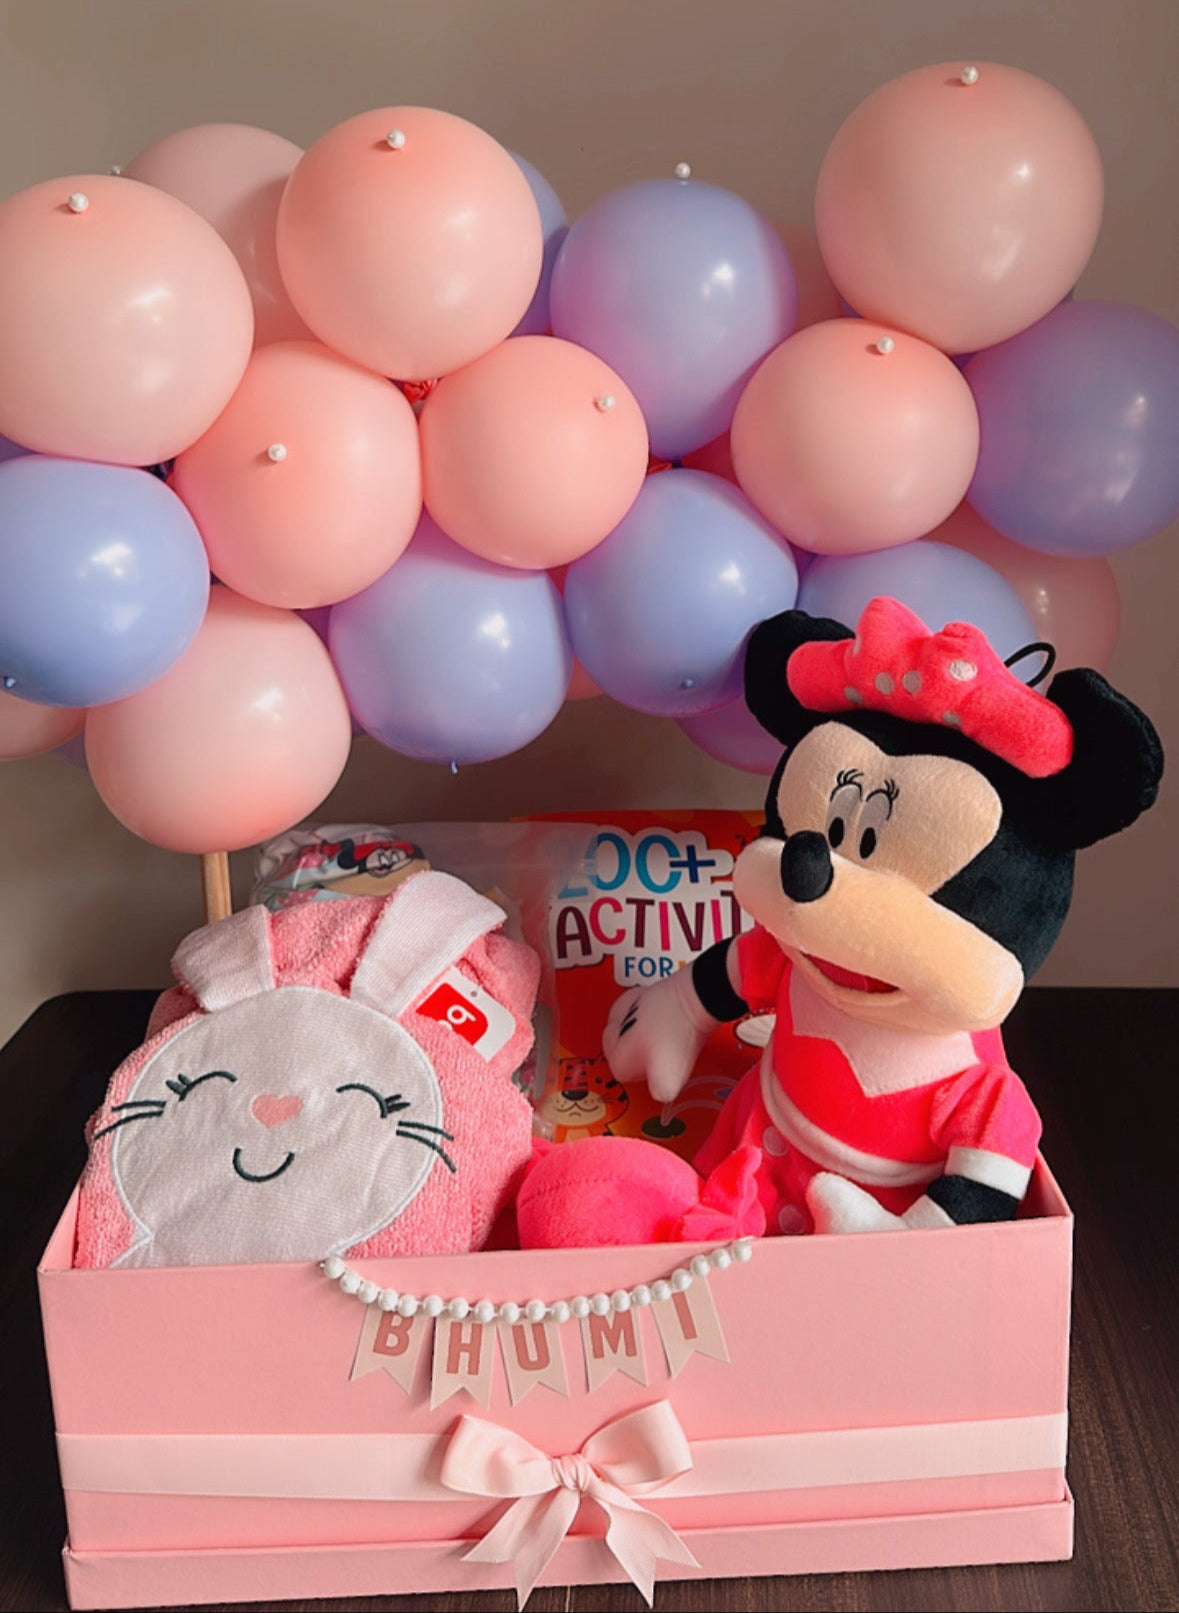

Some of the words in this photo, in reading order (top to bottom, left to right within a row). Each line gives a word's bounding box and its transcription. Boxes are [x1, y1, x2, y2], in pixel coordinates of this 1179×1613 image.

[556, 891, 741, 959] ACTIVIT
[624, 956, 674, 978] FOR
[373, 1292, 697, 1375] BHUMI
